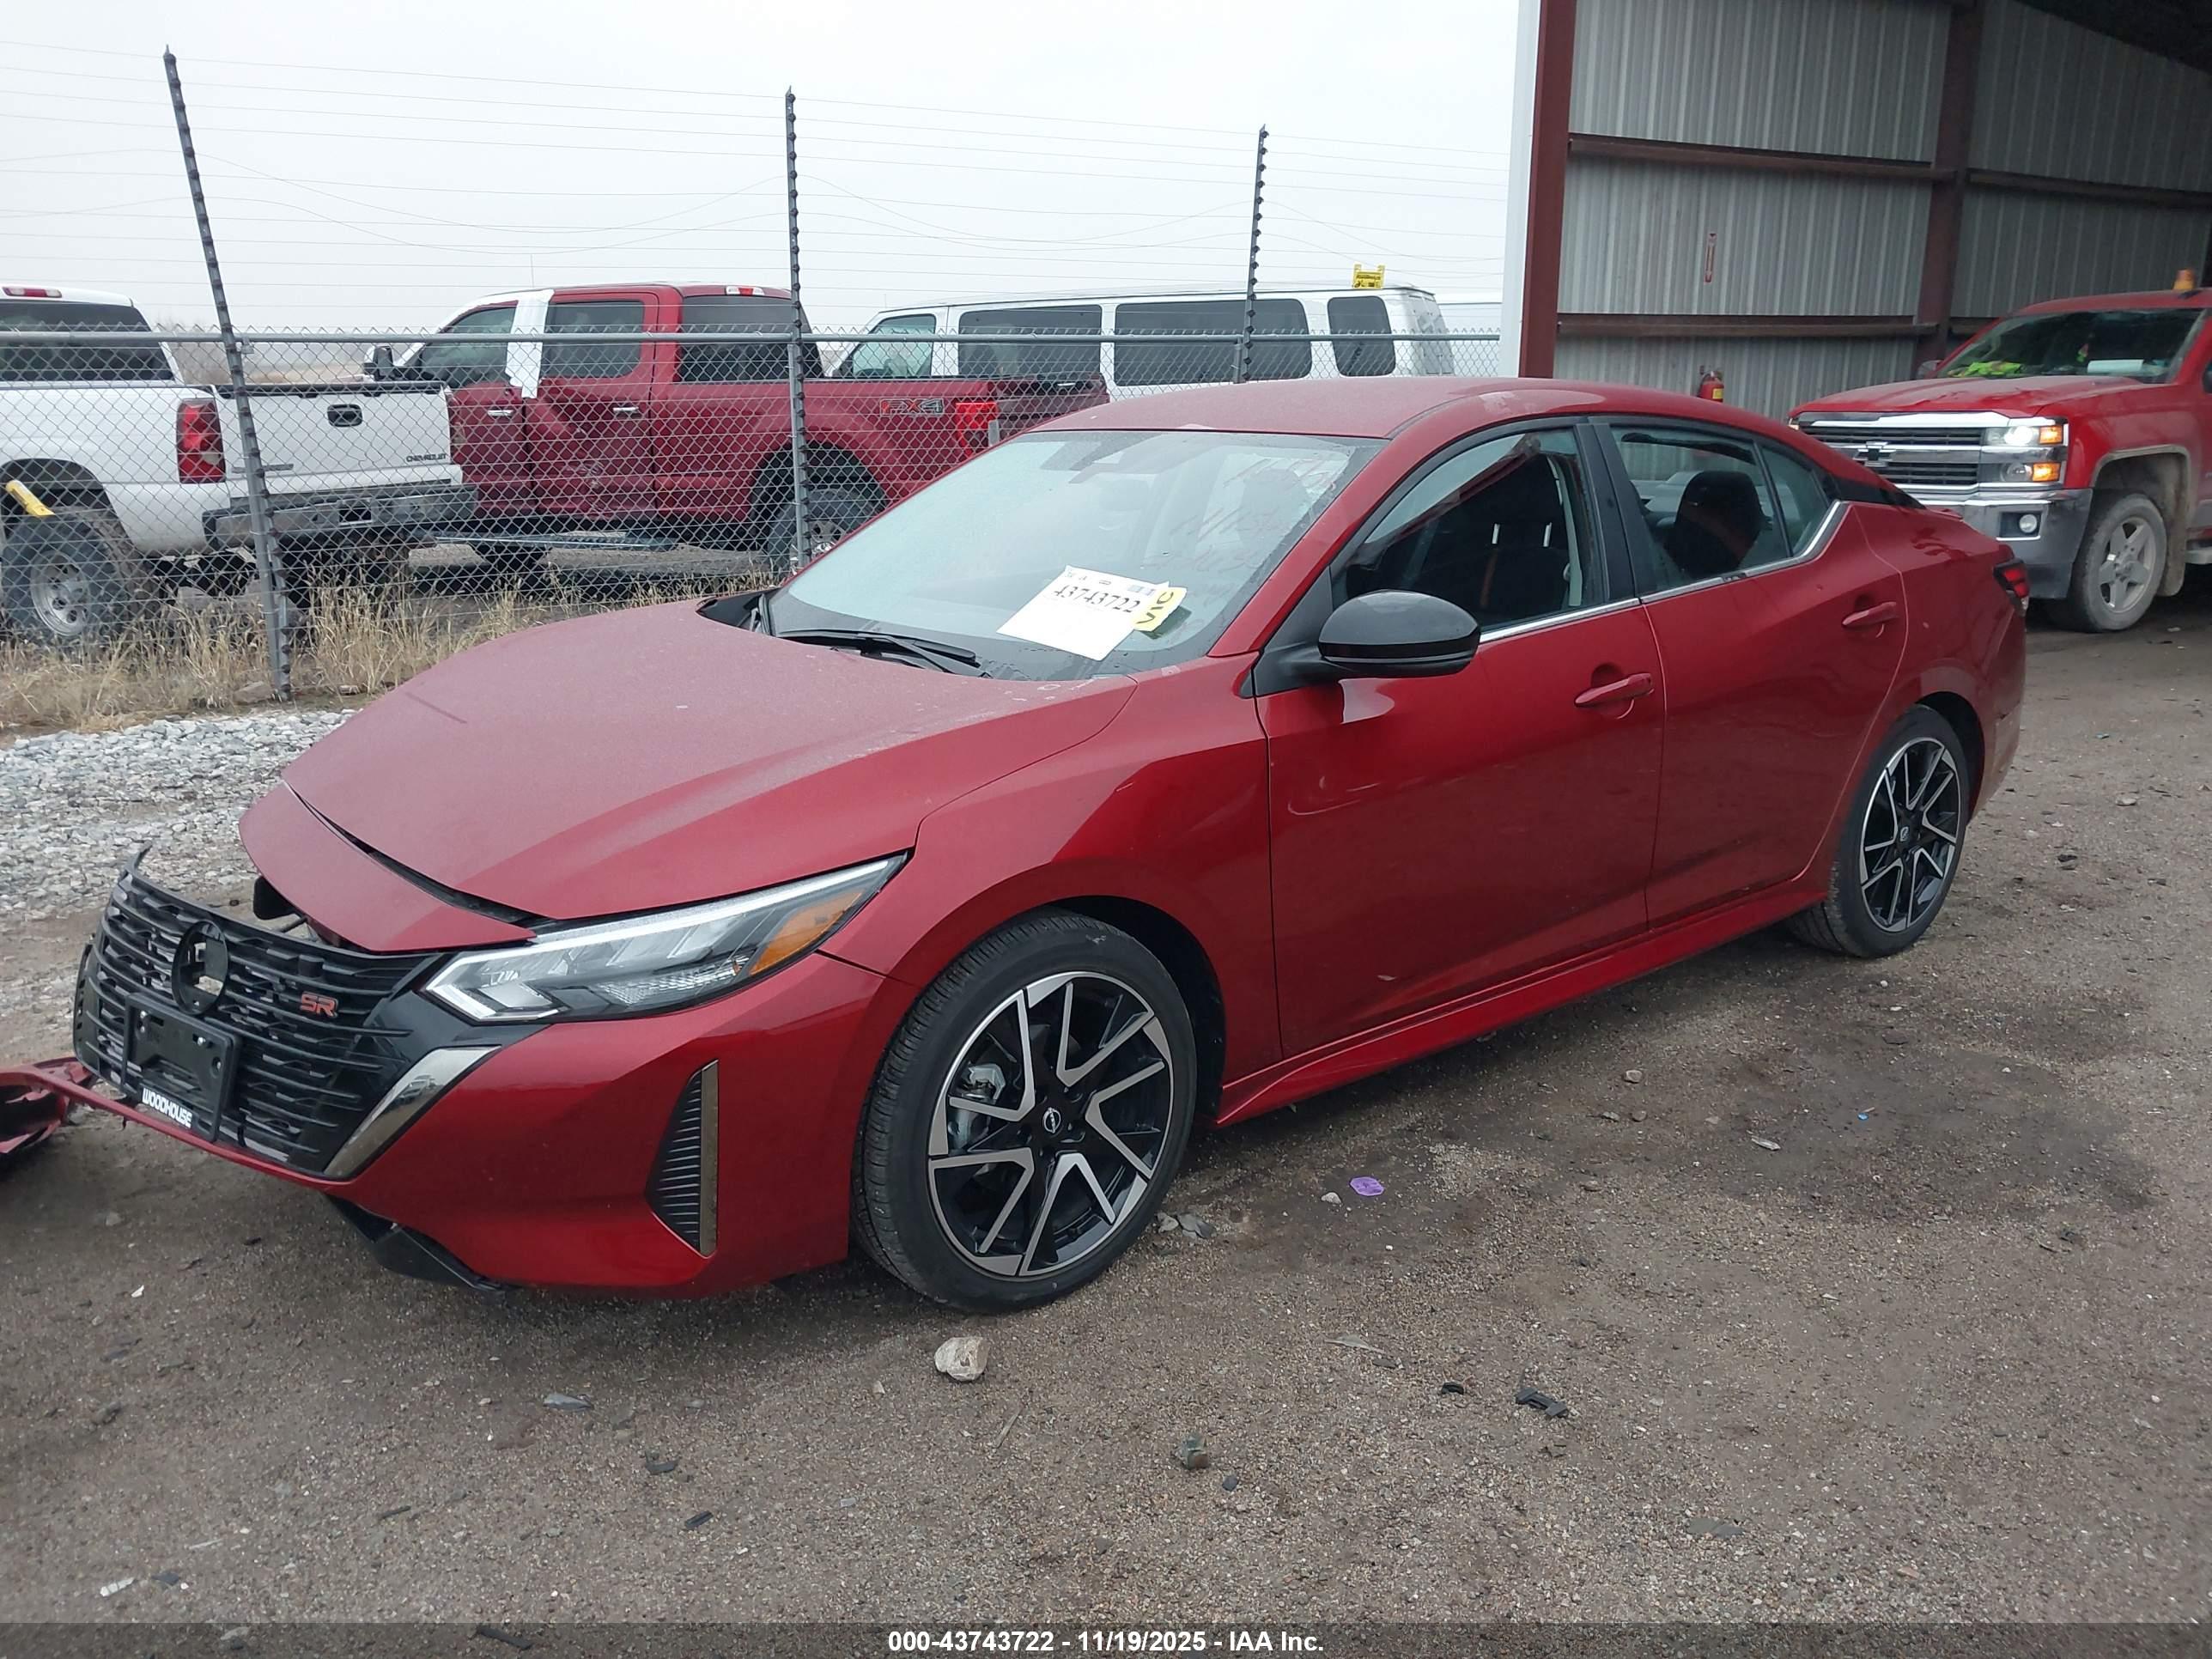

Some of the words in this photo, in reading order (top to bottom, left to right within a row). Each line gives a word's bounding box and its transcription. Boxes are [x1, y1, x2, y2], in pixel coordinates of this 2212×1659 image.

[1054, 585, 1141, 612] 43743722
[300, 992, 337, 1018] SR
[142, 1087, 193, 1128] WOODHOUSE
